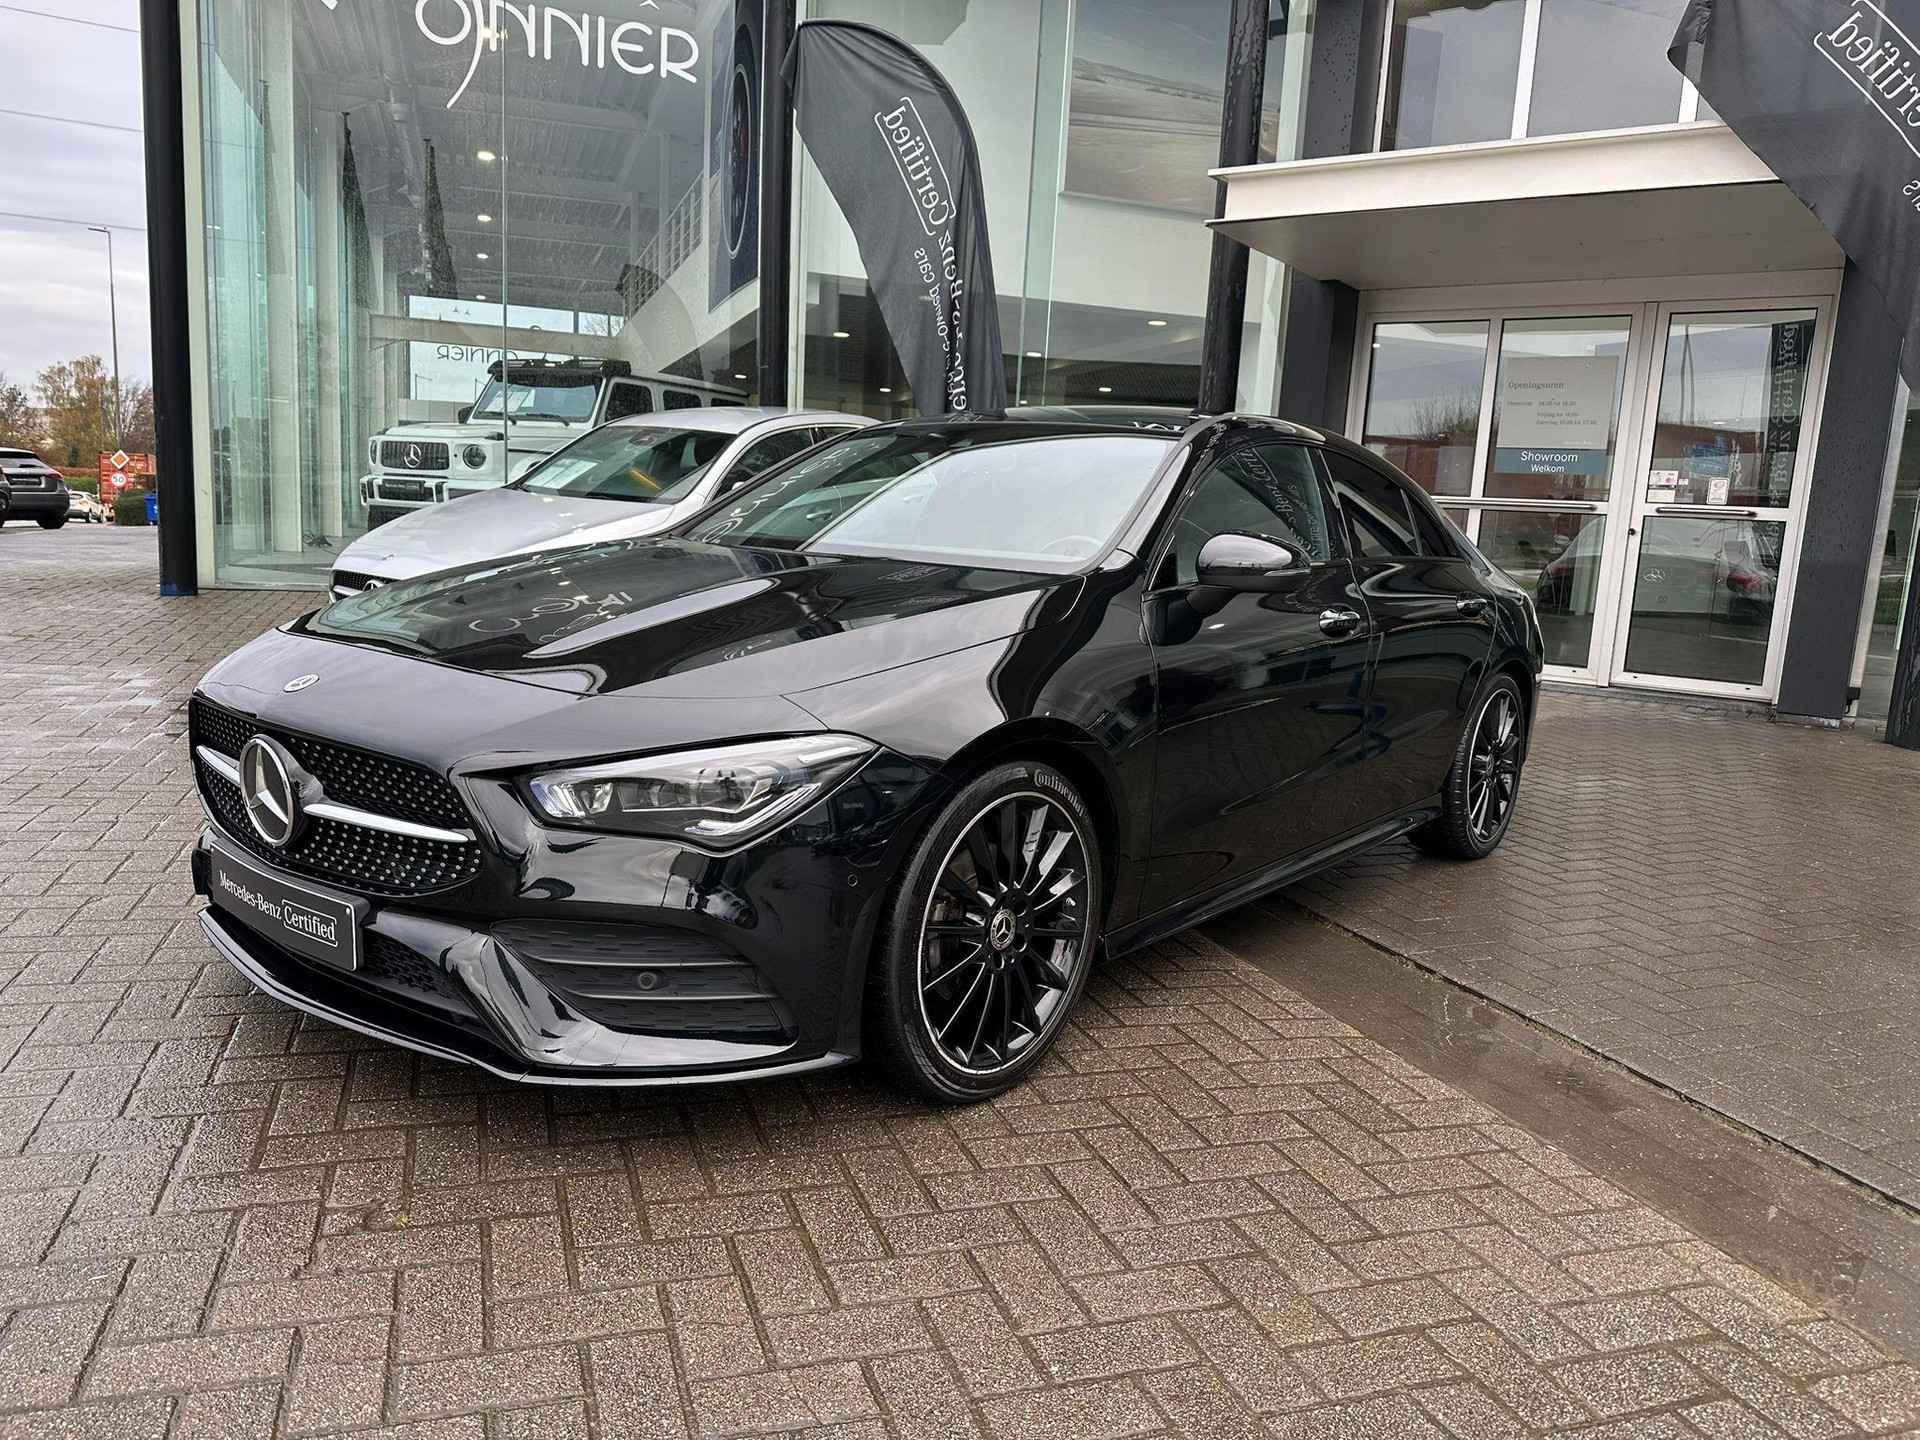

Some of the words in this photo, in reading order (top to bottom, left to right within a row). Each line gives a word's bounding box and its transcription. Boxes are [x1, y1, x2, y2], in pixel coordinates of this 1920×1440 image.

[1520, 450, 1579, 462] Showroom
[1531, 463, 1565, 473] Welkom
[219, 869, 282, 920] Mercedes-Benz
[284, 905, 336, 941] Certified
